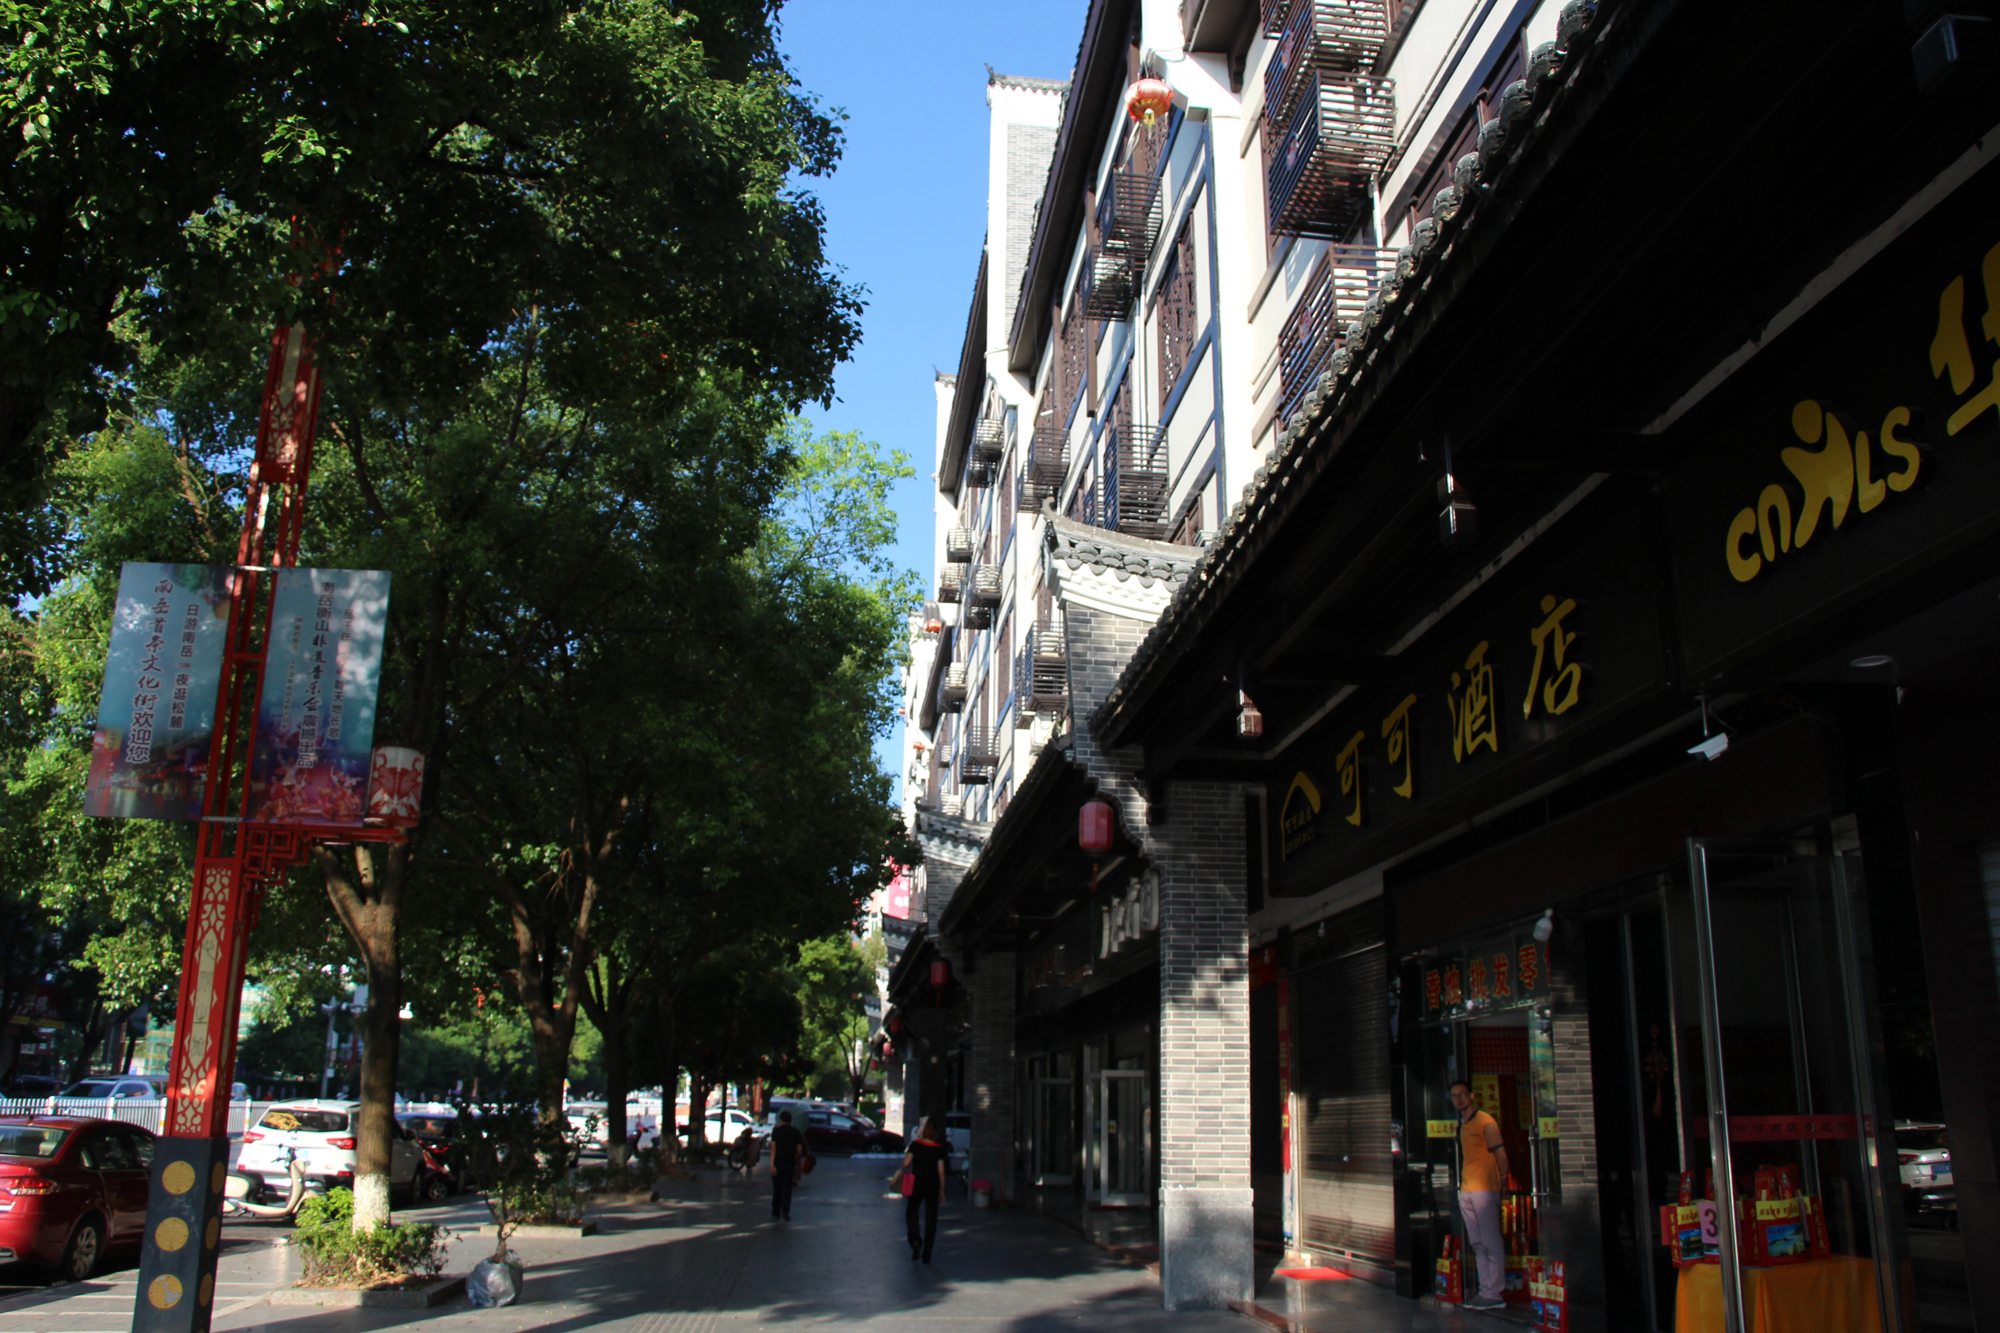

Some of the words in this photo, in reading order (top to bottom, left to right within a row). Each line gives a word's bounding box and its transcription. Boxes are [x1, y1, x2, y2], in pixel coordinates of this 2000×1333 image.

[125, 579, 175, 764] 南岳首条文化街欢迎您
[179, 603, 200, 659] 日游南岳
[296, 581, 335, 769] 南岳衡山非遗音乐会震撼出品
[168, 672, 190, 730] 夜逛松麓
[1336, 594, 1584, 828] 可可酒店
[1426, 940, 1551, 1011] 香烛批发零
